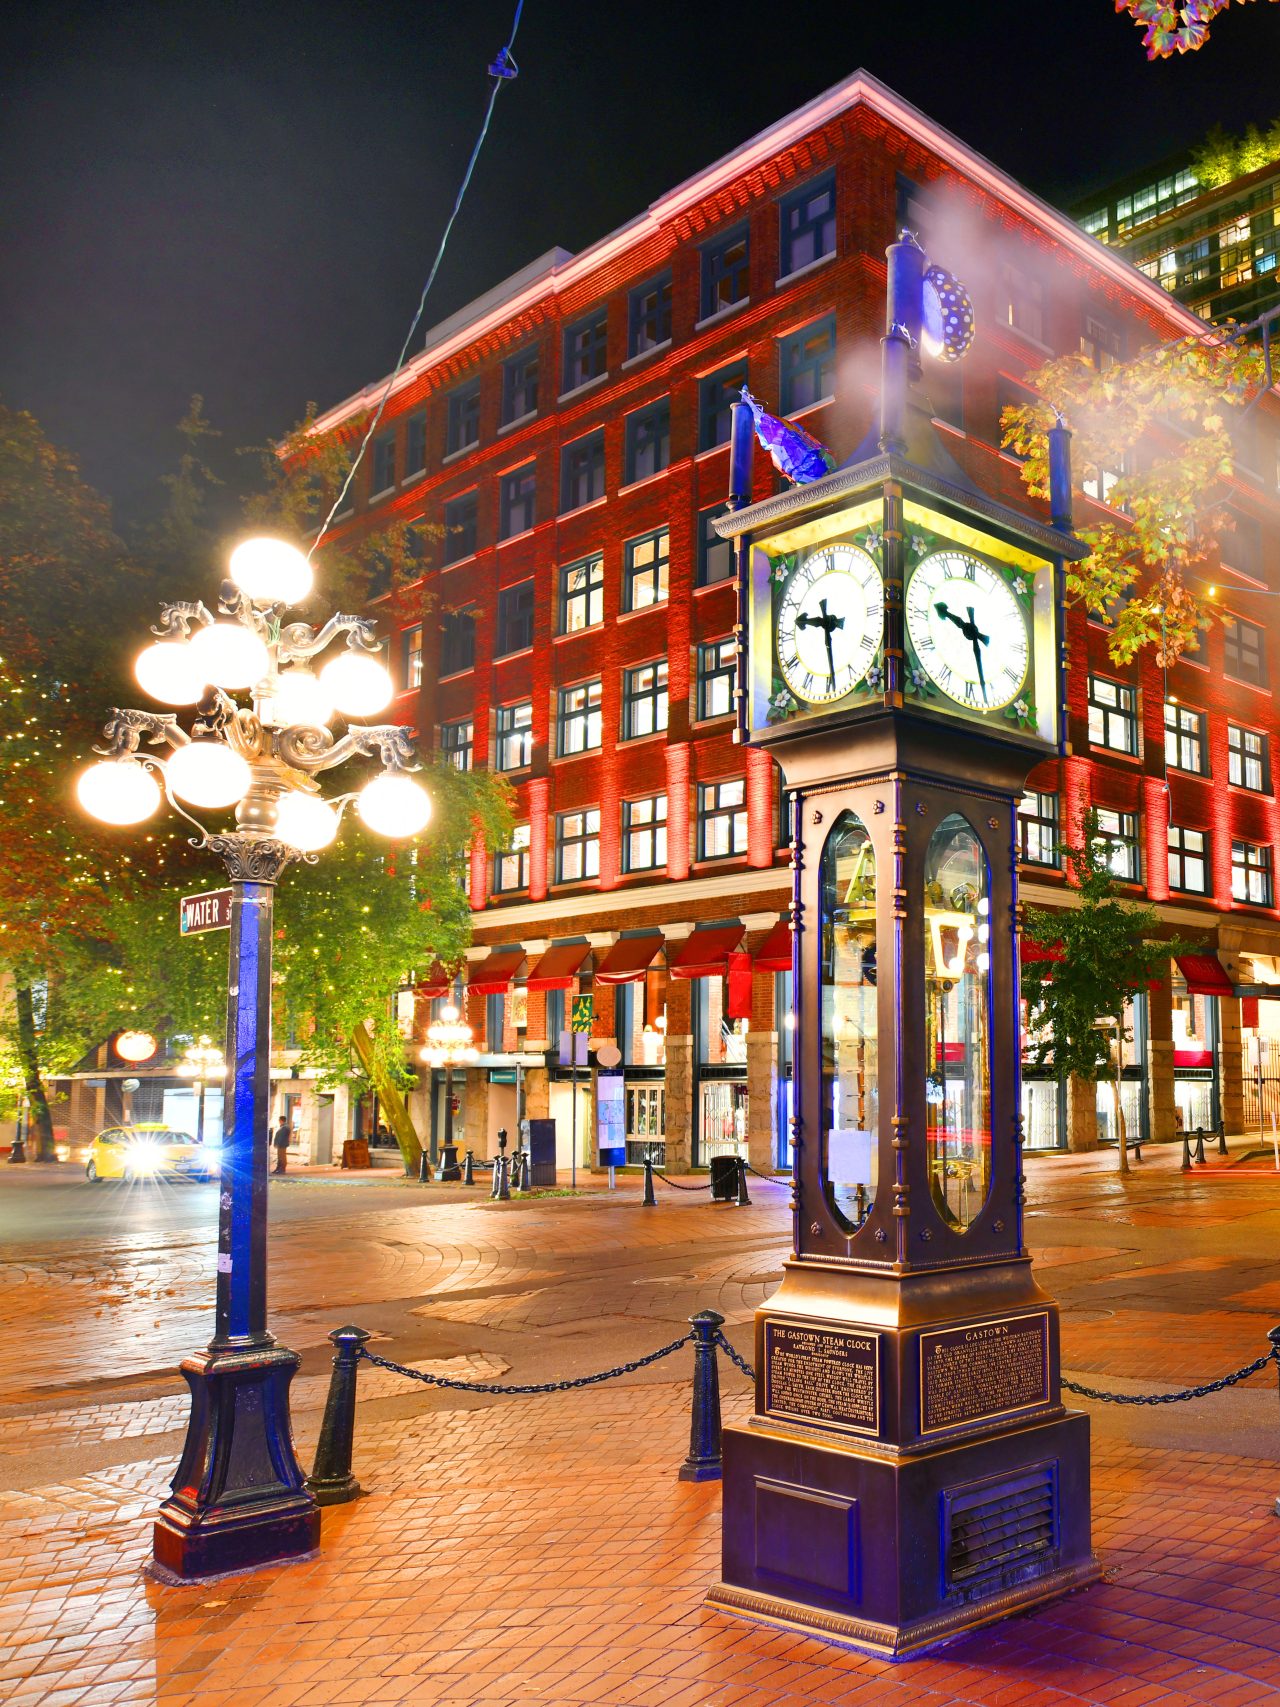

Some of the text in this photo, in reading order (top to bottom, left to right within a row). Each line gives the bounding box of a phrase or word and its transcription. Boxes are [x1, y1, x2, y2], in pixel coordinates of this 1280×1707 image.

[187, 898, 219, 927] WATER
[773, 1329, 785, 1338] THE
[787, 1331, 820, 1343] GASTOWN
[822, 1336, 844, 1347] STEAM
[846, 1339, 871, 1351] CLOCK
[965, 1326, 999, 1341] GASTOWN
